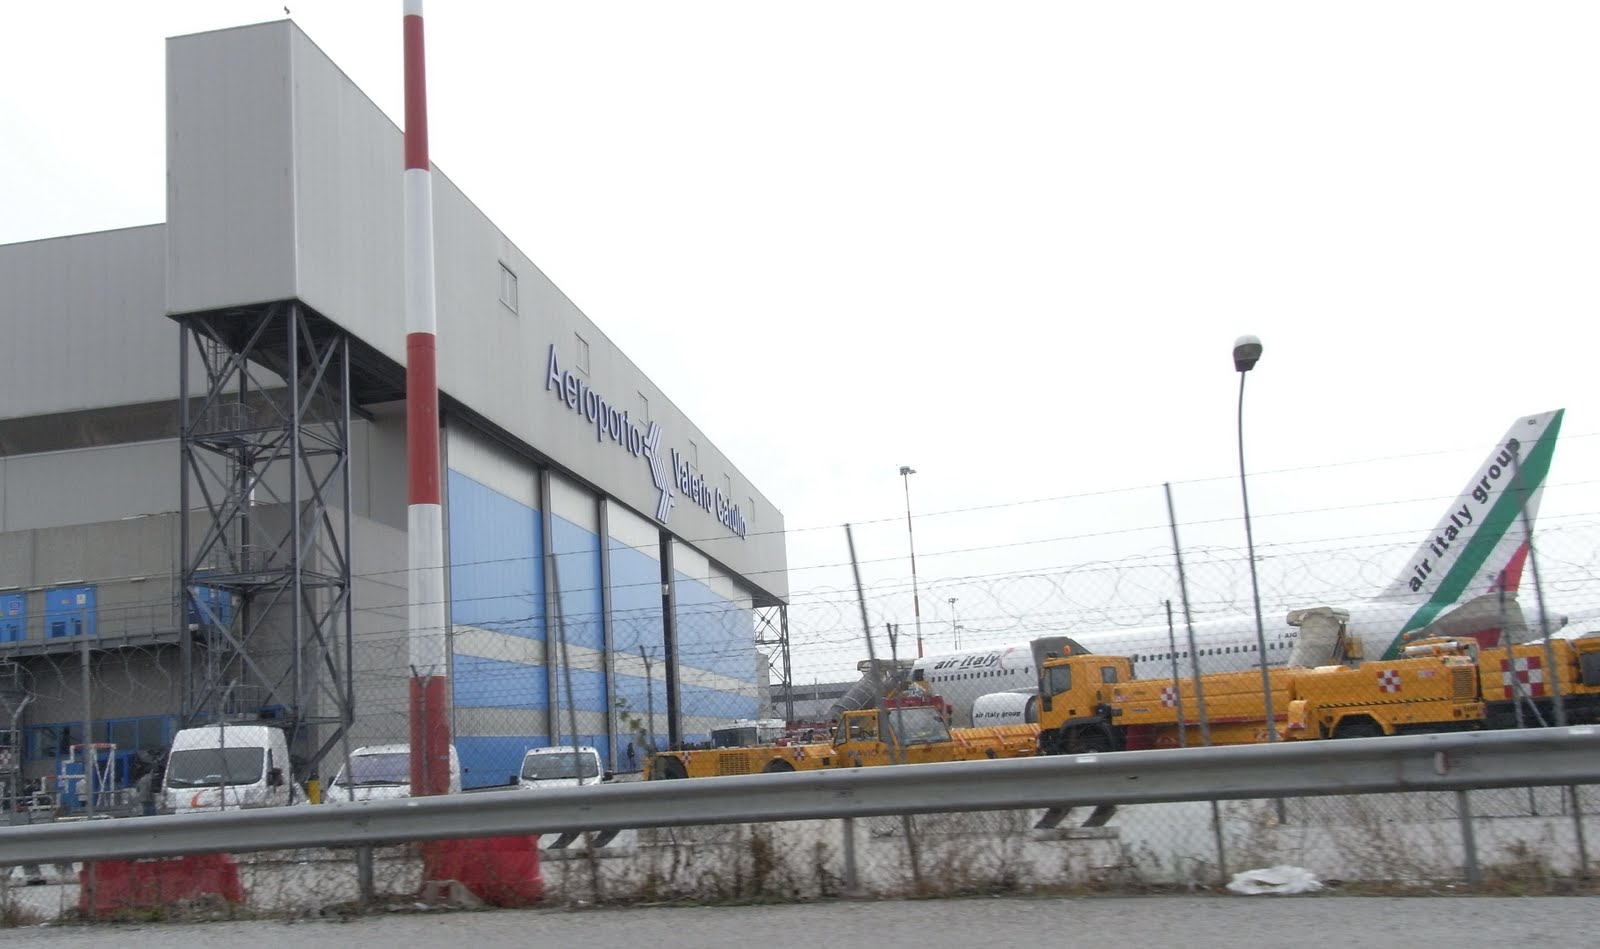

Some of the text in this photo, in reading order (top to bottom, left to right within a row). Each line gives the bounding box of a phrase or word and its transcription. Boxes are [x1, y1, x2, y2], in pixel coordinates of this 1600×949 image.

[546, 344, 642, 457] Aeroporto
[671, 448, 746, 540] Valerio Catullo
[1409, 438, 1520, 592] air italy group
[934, 653, 1001, 670] air italy
[975, 711, 1021, 720] air italy group
